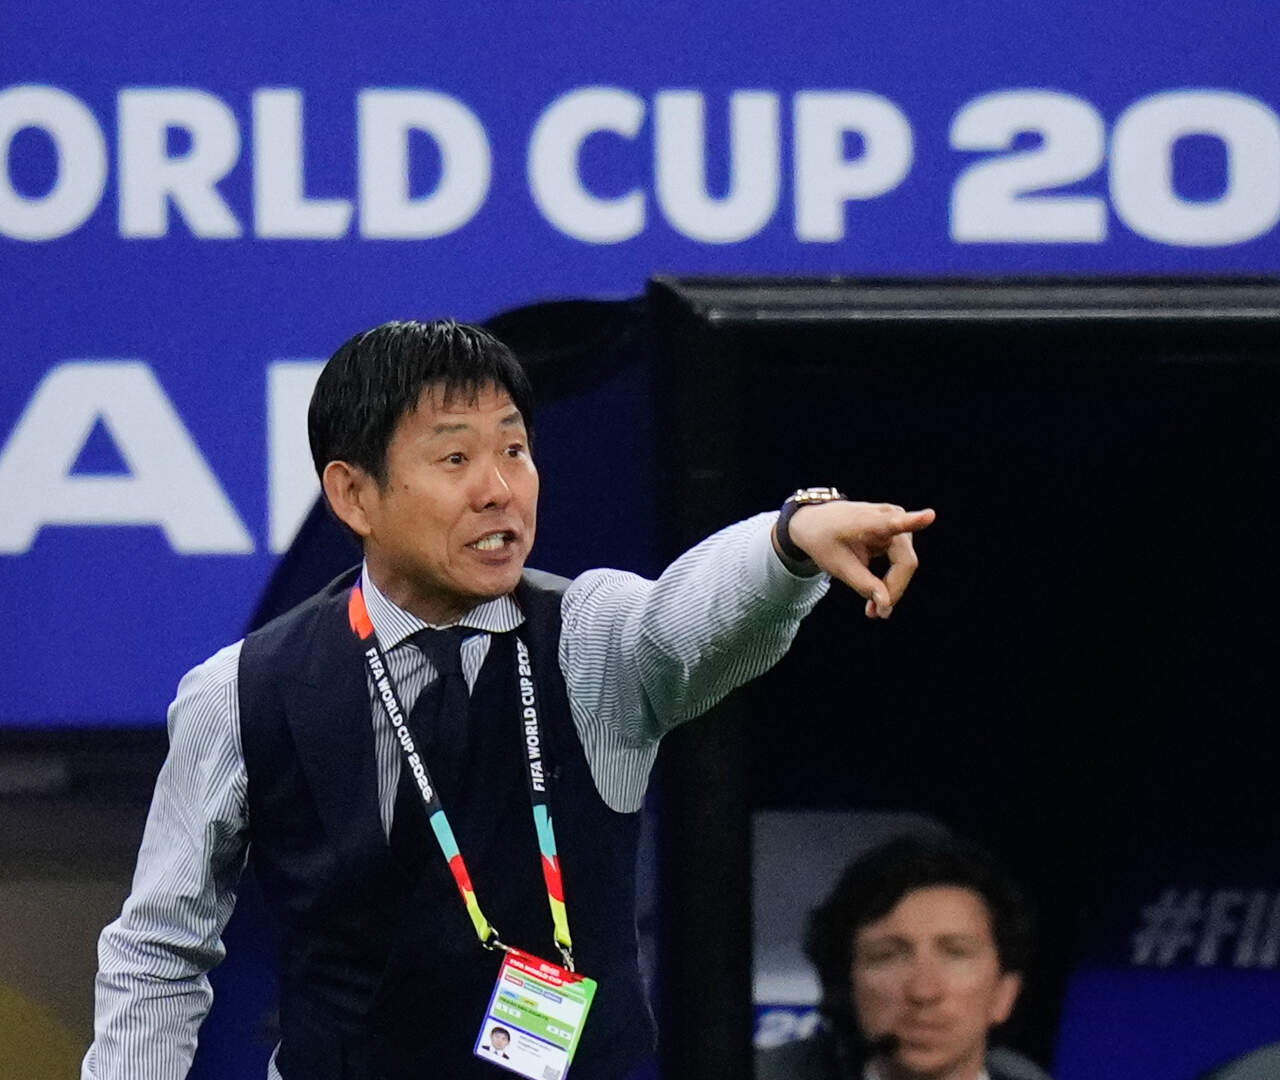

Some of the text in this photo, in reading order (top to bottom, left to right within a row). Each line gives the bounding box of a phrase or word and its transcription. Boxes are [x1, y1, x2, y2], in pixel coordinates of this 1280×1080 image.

[527, 86, 917, 246] CUP
[366, 647, 433, 803] FIFA WORLD CUP 2026
[516, 636, 546, 792] FIFA WORLD CUP 202
